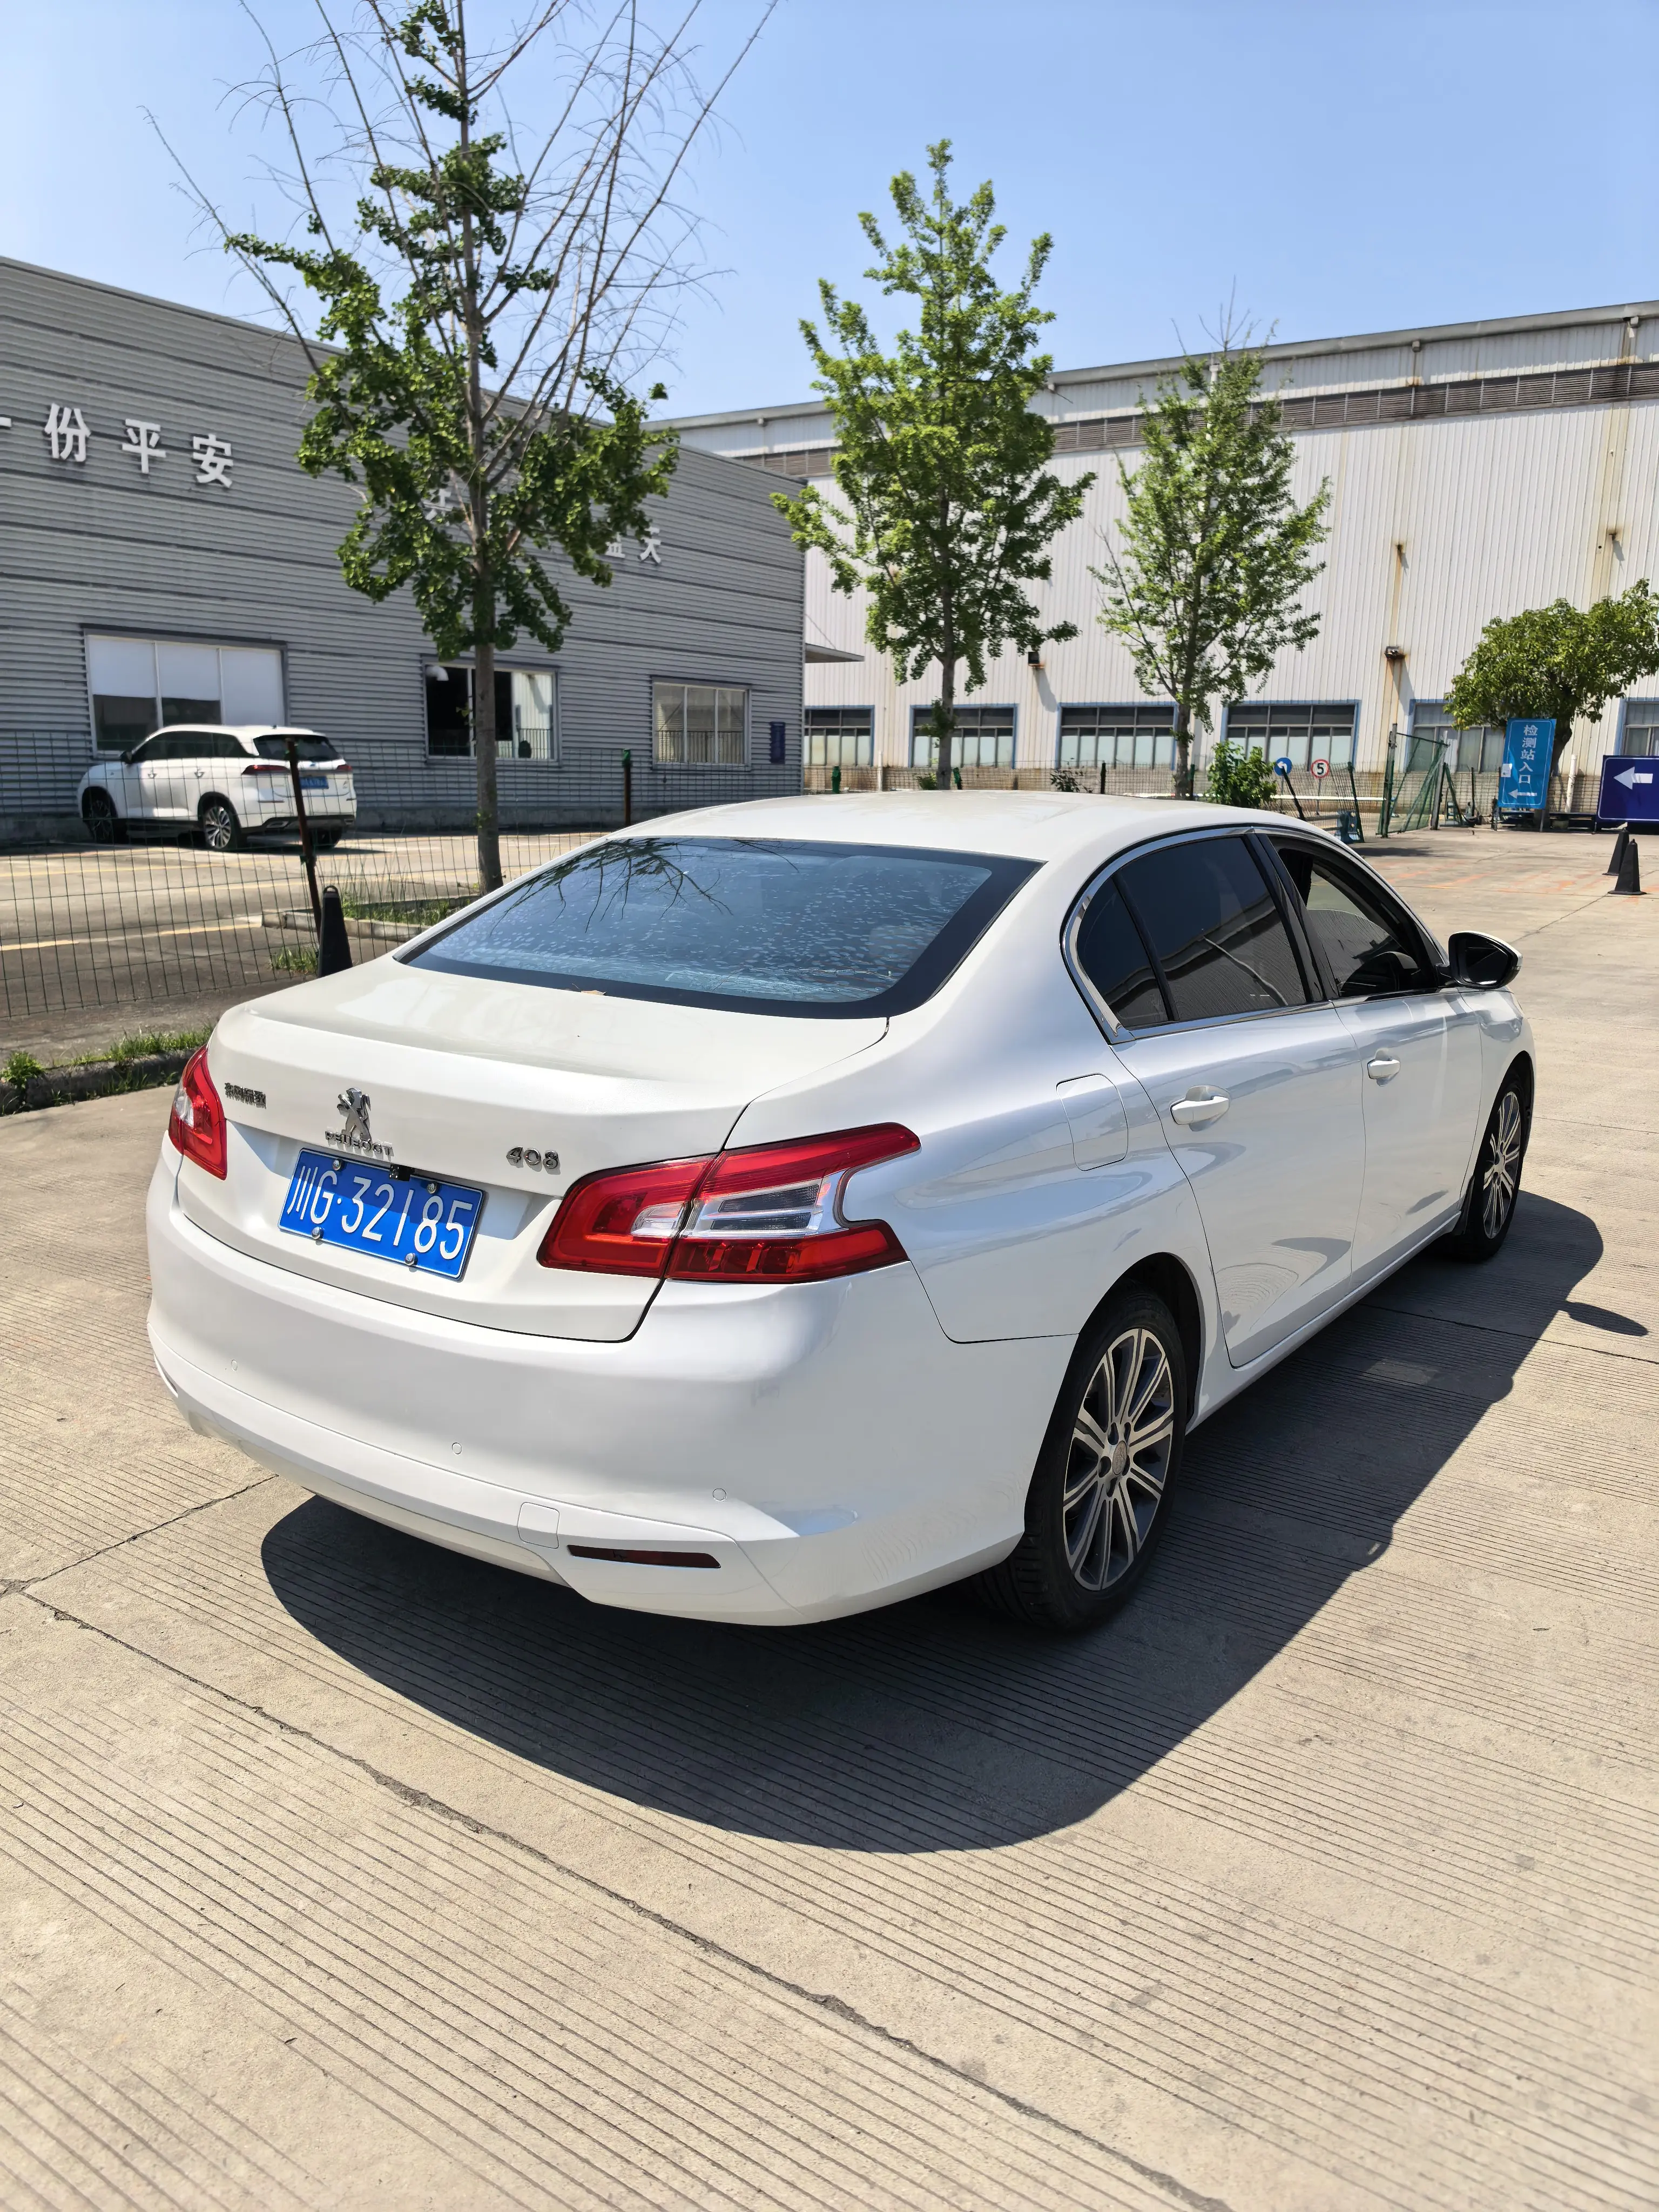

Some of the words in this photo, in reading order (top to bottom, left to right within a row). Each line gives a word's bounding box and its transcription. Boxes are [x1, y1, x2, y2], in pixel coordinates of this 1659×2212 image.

[0, 403, 233, 488] 份平安
[1317, 763, 1324, 775] 5
[1519, 724, 1538, 784] 检测站入口
[506, 1145, 558, 1169] 408
[287, 1165, 473, 1260] 川G·32185
